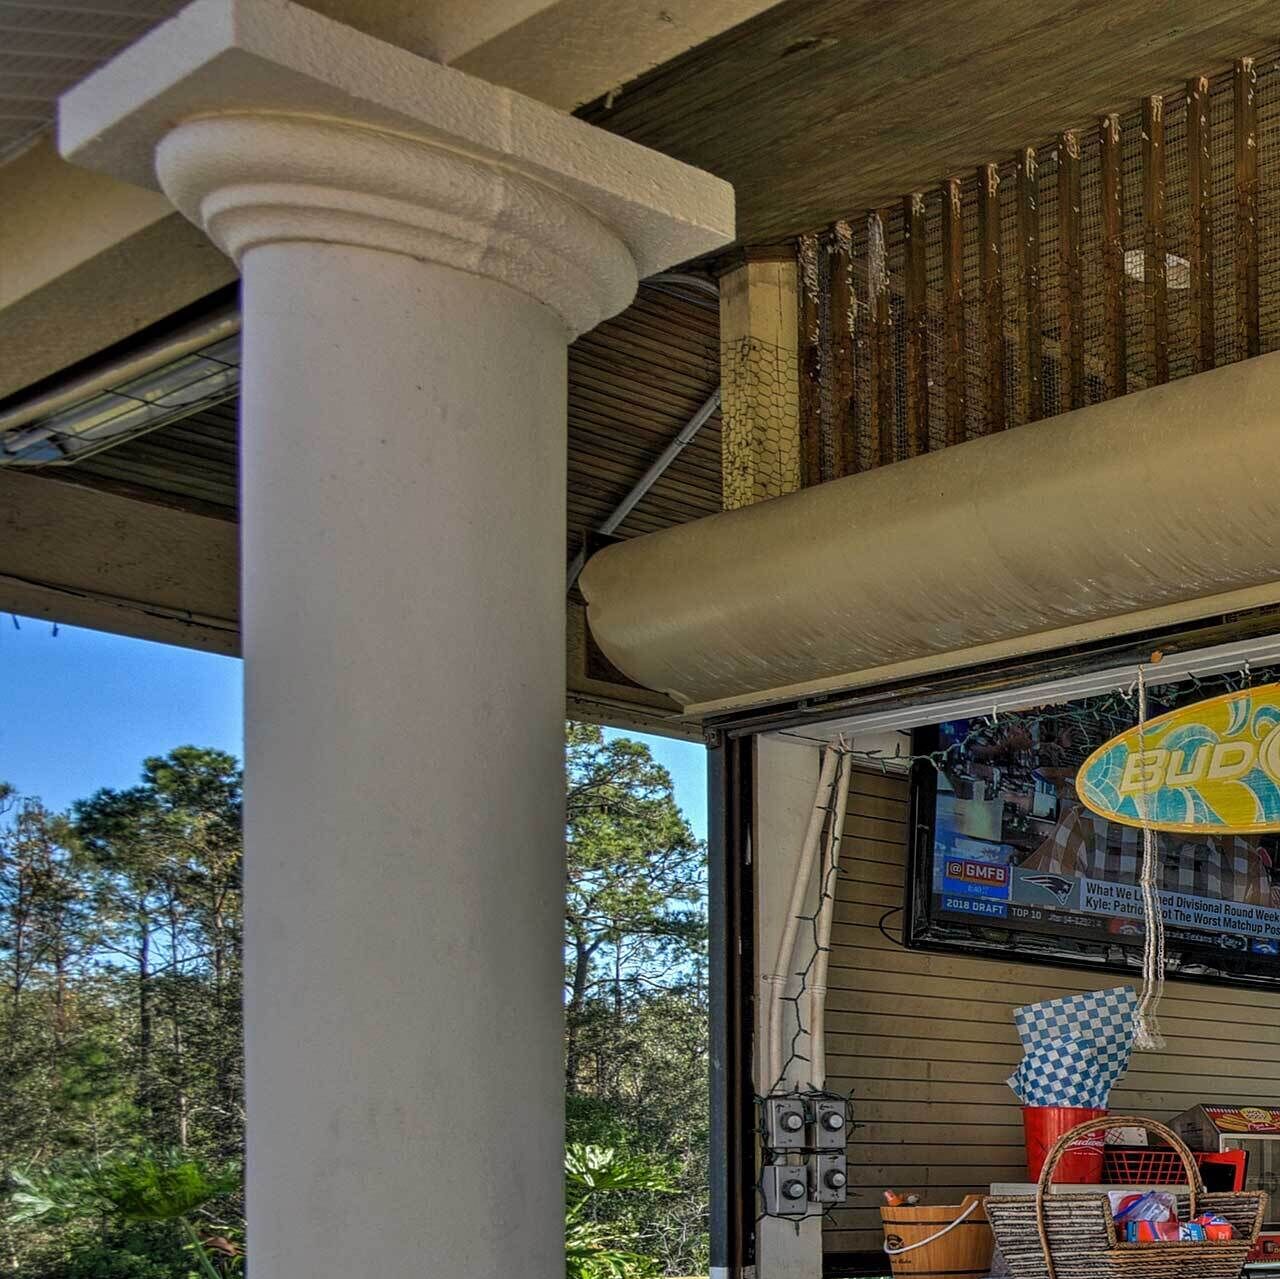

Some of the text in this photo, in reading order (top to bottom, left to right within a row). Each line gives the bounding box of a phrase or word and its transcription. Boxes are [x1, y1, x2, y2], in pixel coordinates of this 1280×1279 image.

[1120, 740, 1255, 793] BUD
[966, 864, 1005, 881] GMFB
[947, 898, 1042, 919] 2018 DRAFT TOP 10
[1086, 882, 1113, 897] What
[1116, 887, 1132, 899] We
[1176, 896, 1222, 913] Divisional
[1224, 904, 1253, 918] Round
[1174, 909, 1191, 922] The
[1194, 912, 1221, 927] Worst
[1223, 918, 1263, 934] Matchup
